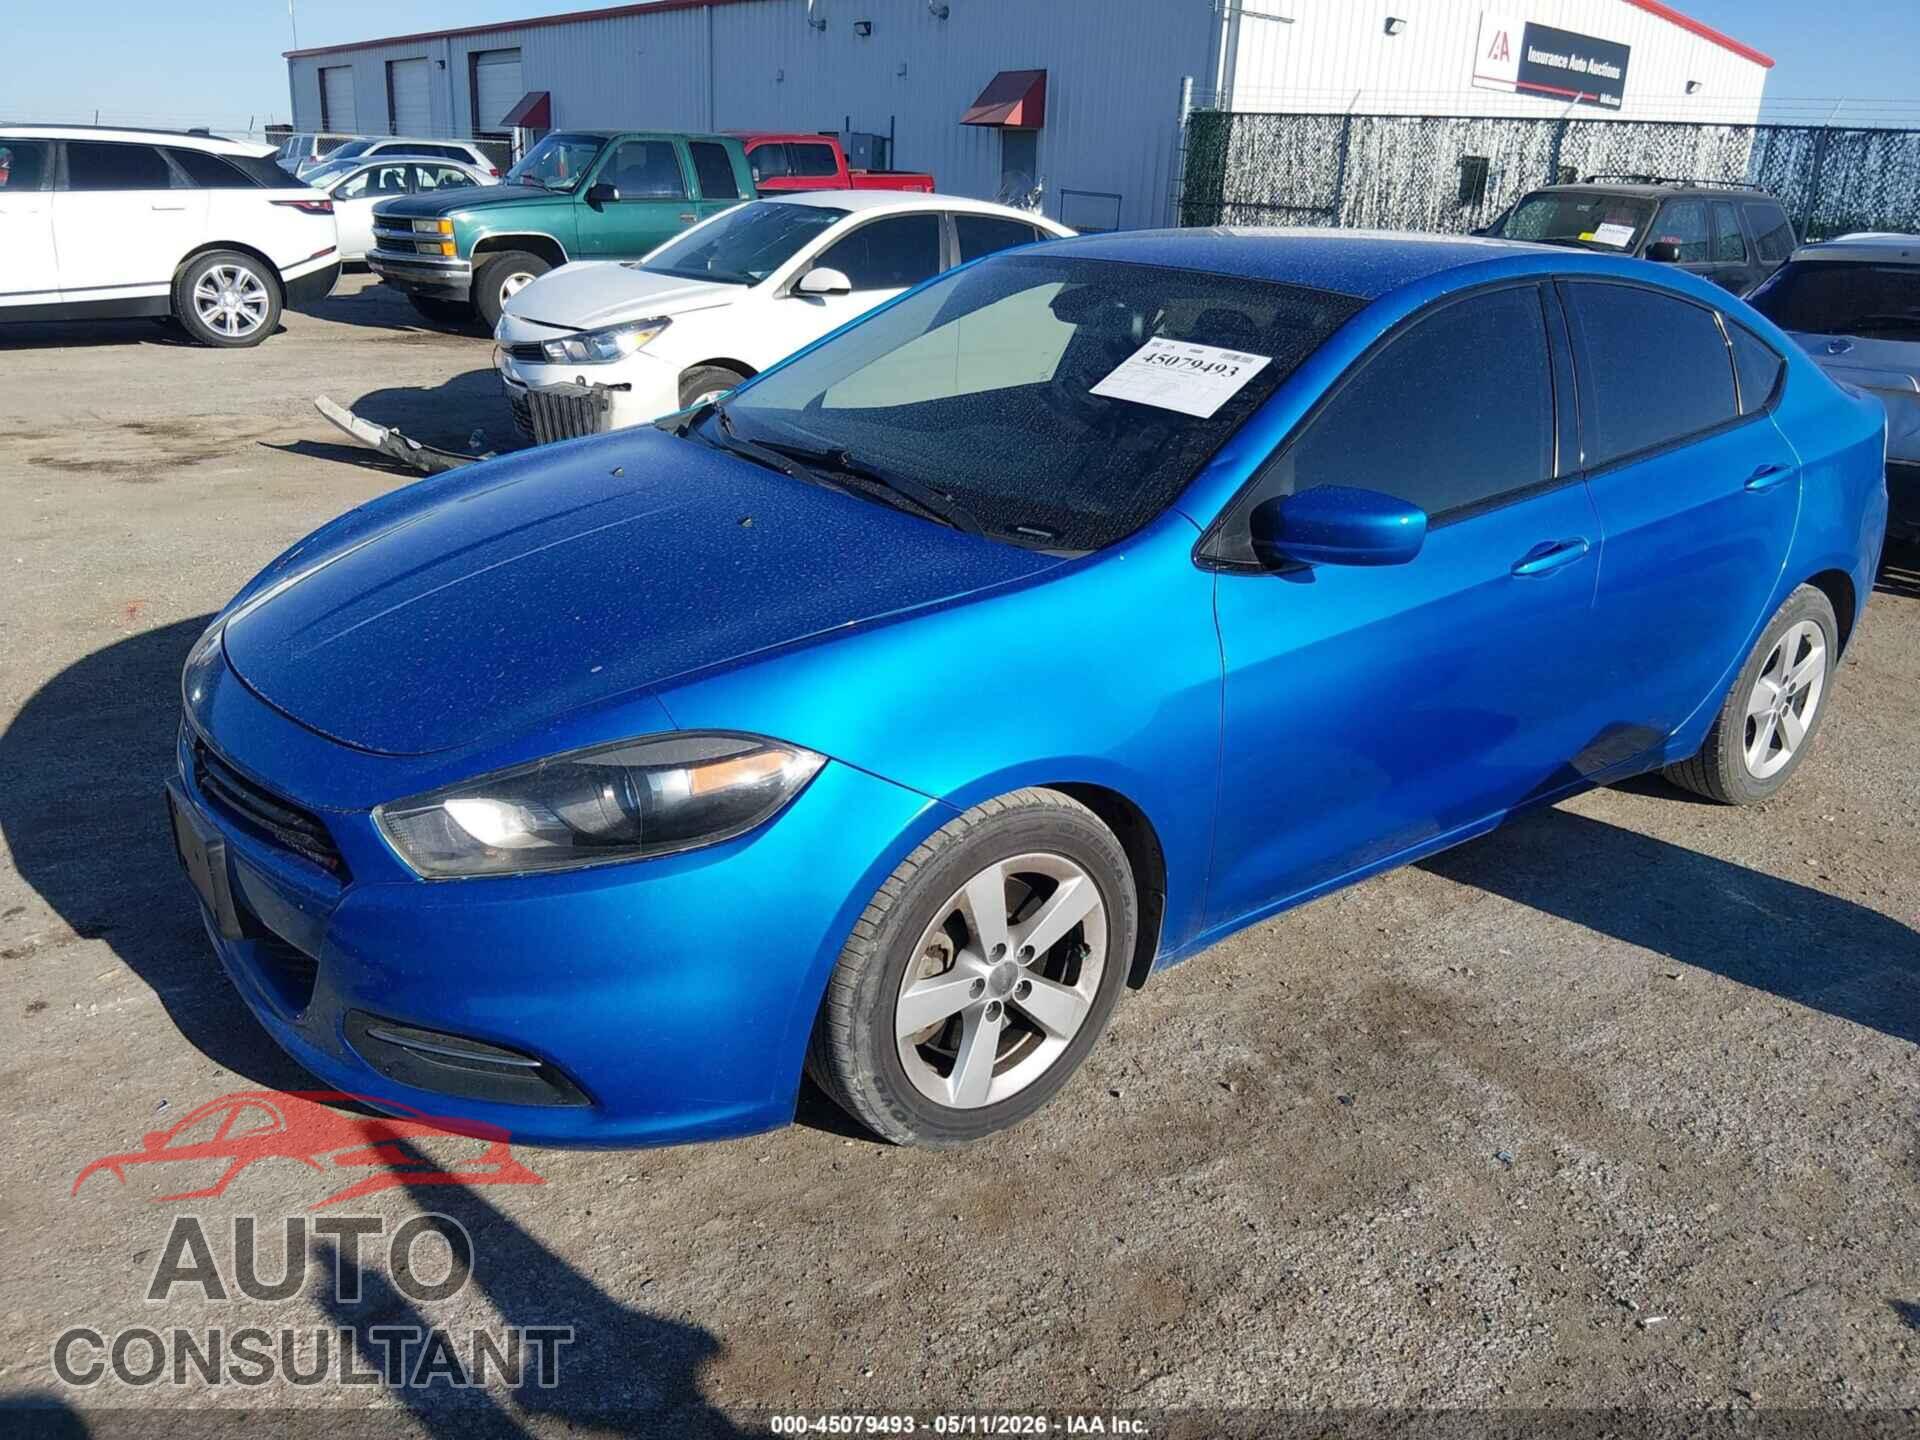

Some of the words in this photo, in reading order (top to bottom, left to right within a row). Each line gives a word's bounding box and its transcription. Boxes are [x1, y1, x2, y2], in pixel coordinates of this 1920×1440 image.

[1527, 45, 1568, 69] Insurance
[1568, 54, 1587, 72] Auto
[1587, 58, 1621, 80] Auctions
[1143, 352, 1239, 377] 45079493
